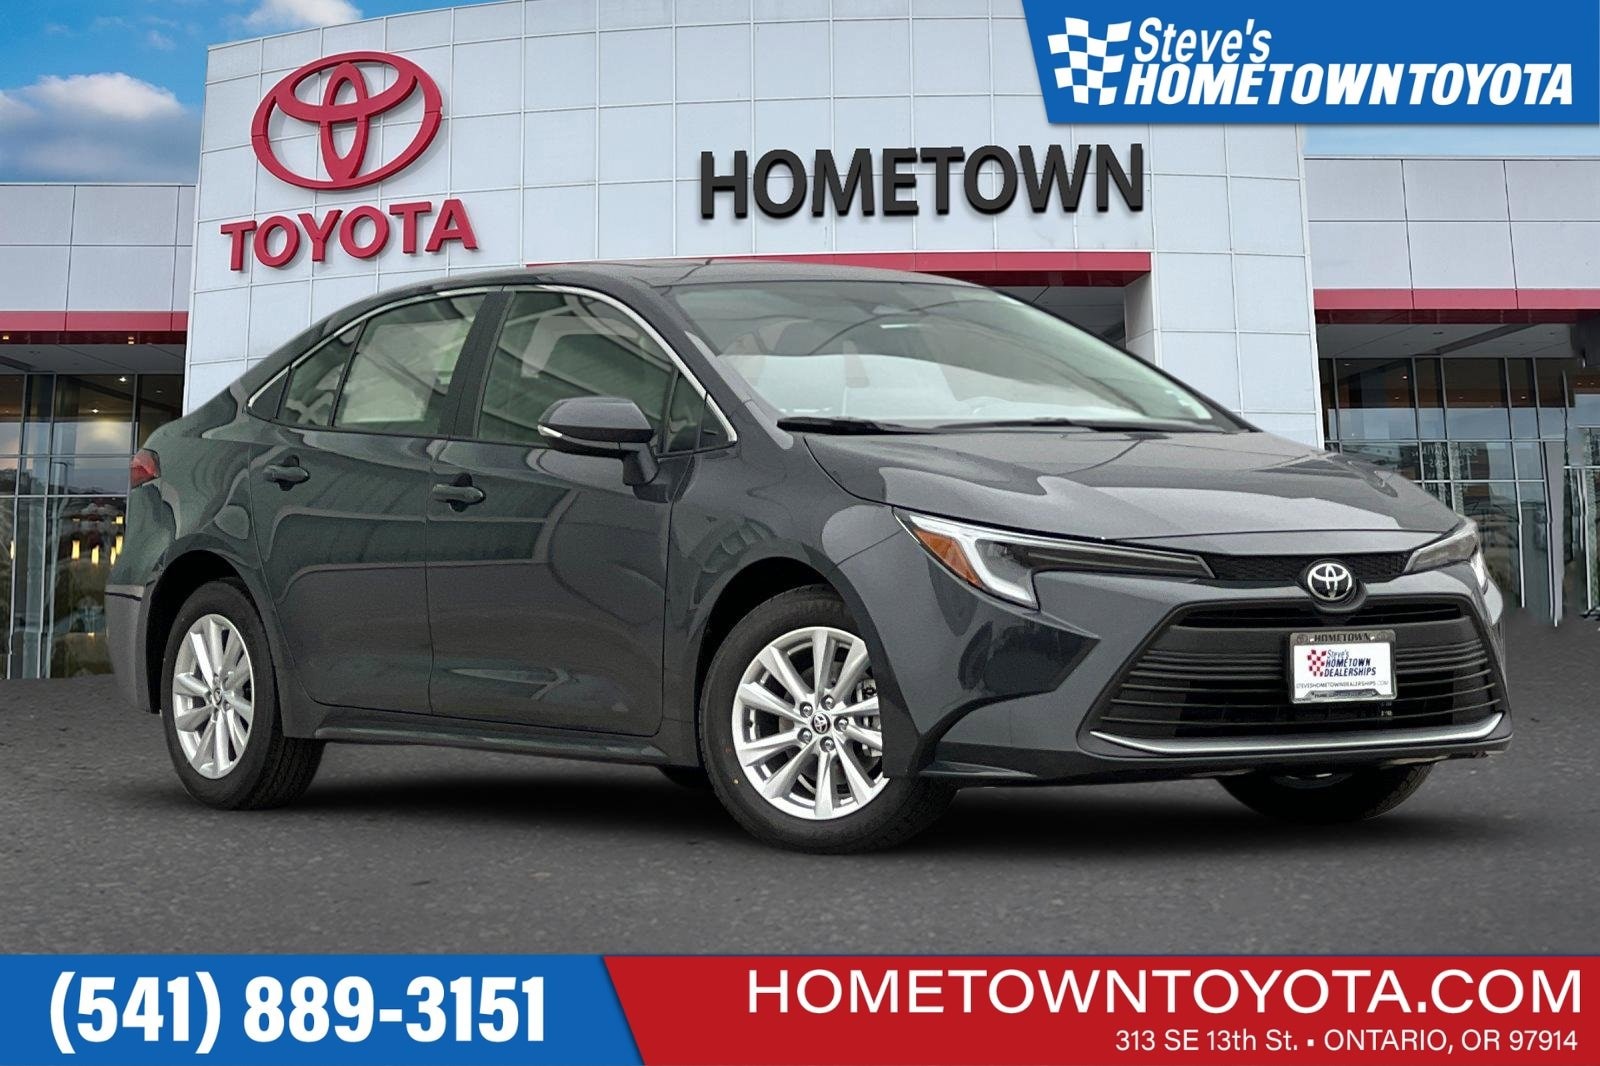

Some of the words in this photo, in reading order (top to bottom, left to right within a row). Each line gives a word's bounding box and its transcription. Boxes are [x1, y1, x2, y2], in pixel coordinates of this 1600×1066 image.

[700, 143, 1145, 219] HOMETOWN
[220, 198, 478, 271] TOYOTA
[1314, 632, 1370, 642] HOMETOWN
[1327, 649, 1350, 659] Steve's
[1325, 658, 1371, 668] HOMETOWN
[1324, 667, 1377, 678] DEALERSHIPS
